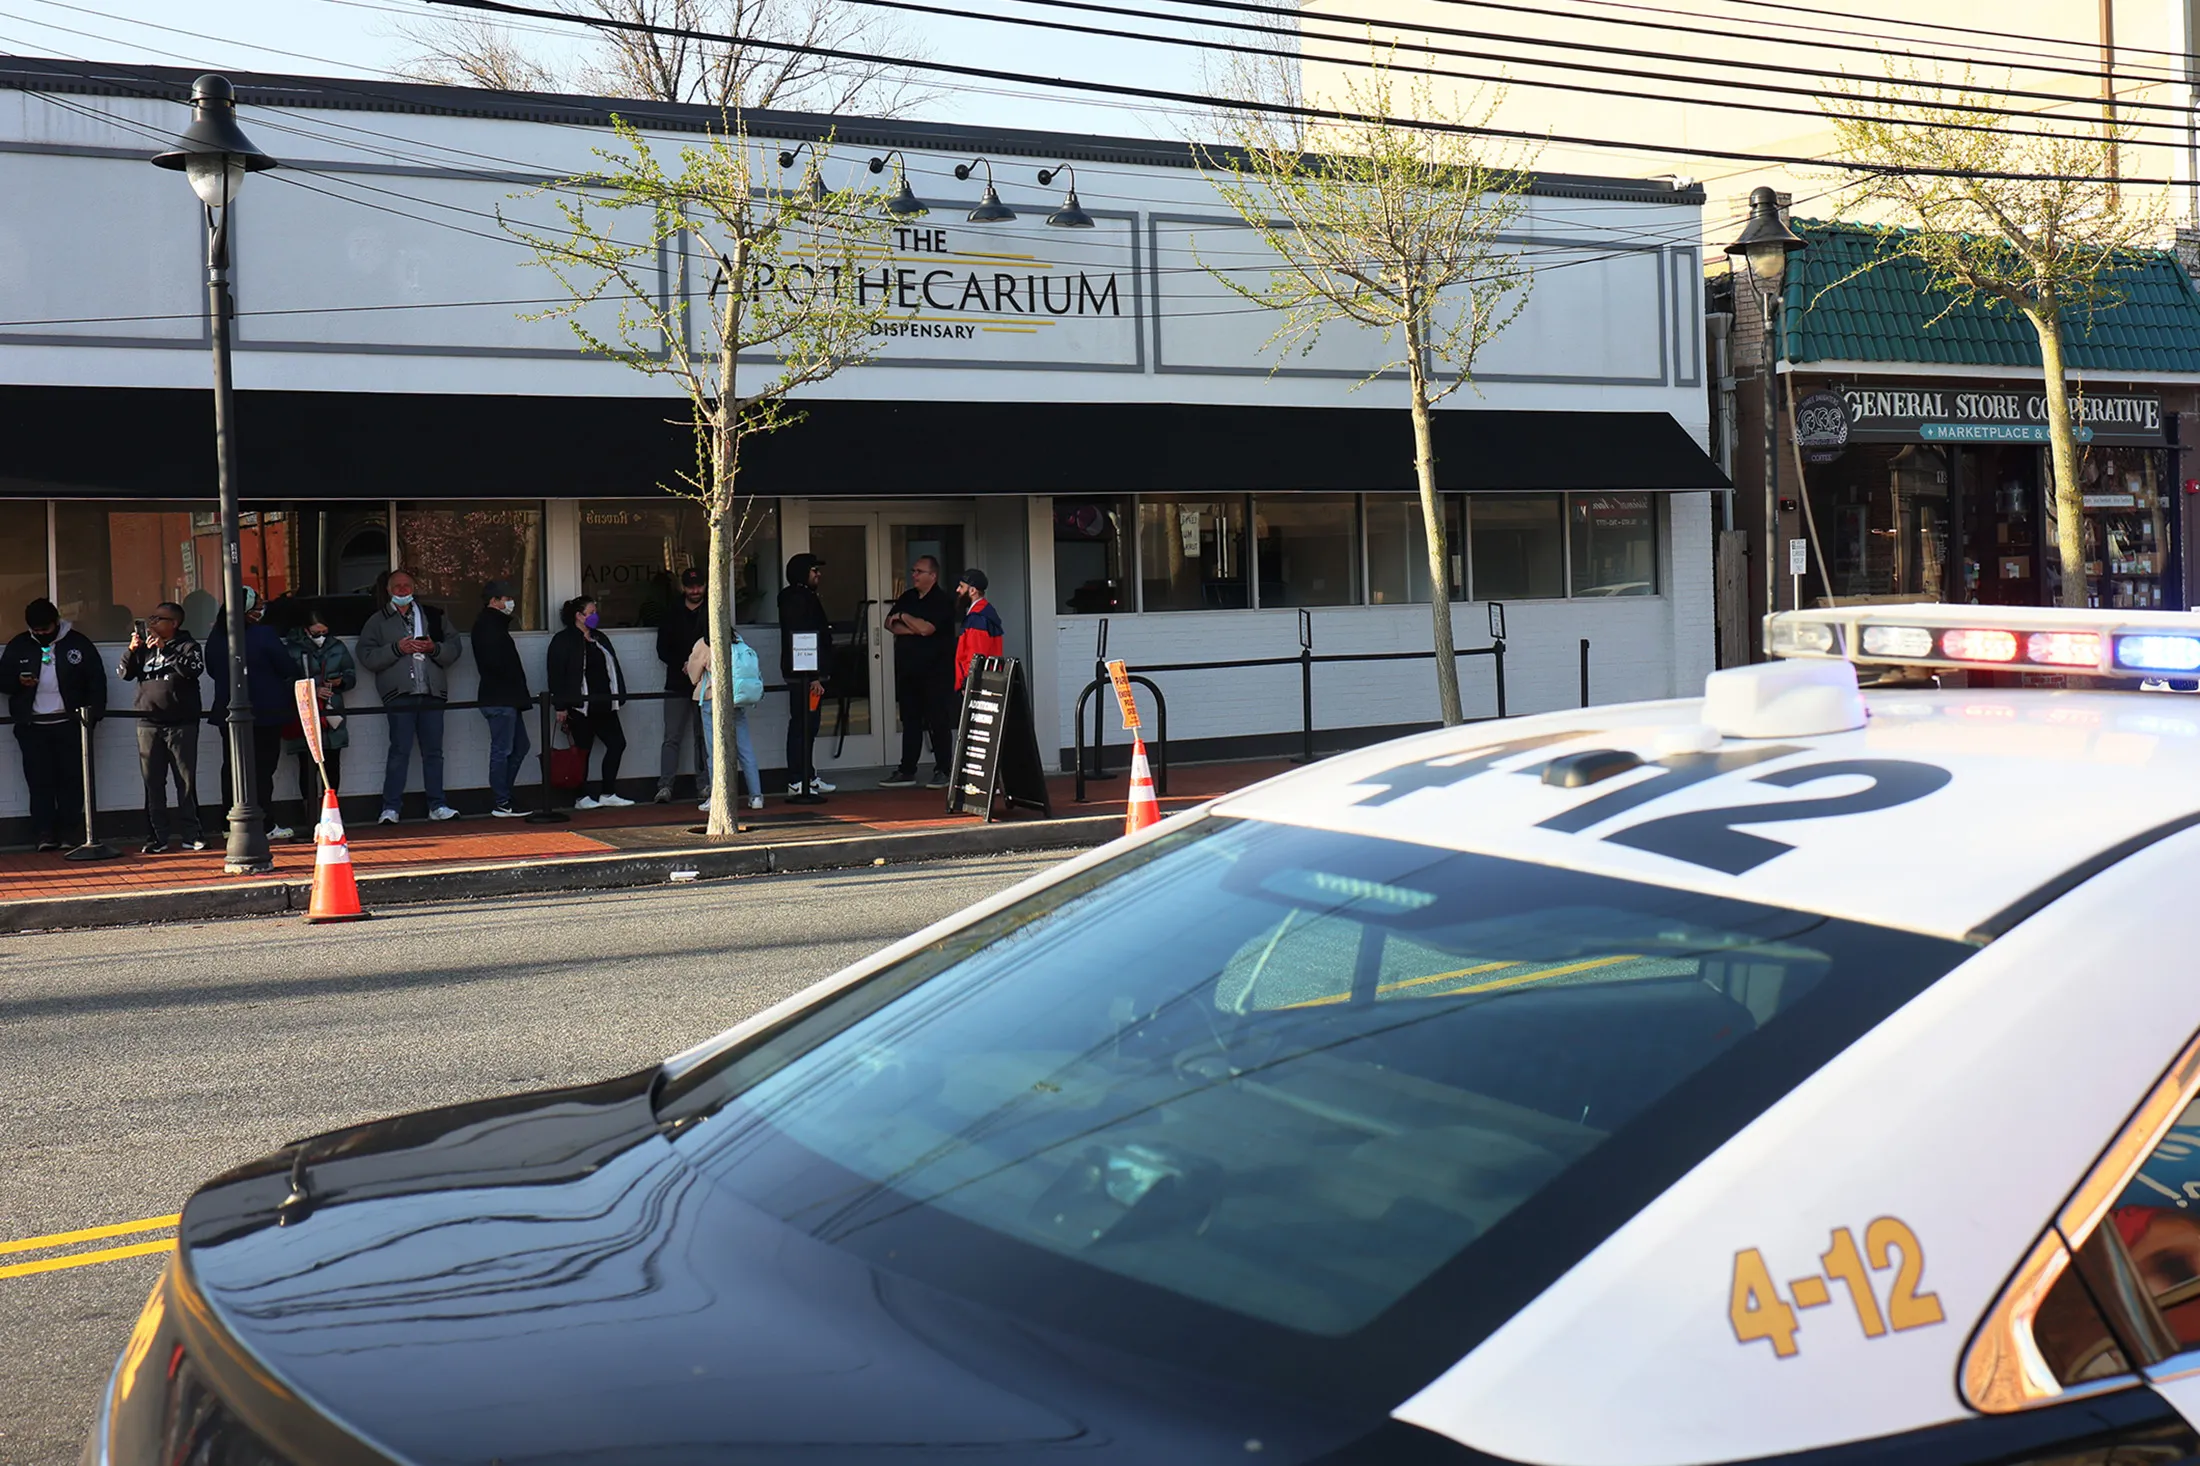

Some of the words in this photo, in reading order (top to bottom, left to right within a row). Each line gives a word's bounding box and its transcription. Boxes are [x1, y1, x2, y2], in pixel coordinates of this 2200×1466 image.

[893, 227, 948, 253] THE
[708, 253, 1120, 316] APOTHECARIUM
[870, 322, 976, 339] DISPENSARY
[1844, 391, 1948, 422] GENERAL
[1956, 393, 2021, 419] STORE
[2026, 396, 2160, 429] COPERATIVE
[1938, 427, 2030, 439] MARKETPLACE
[2034, 428, 2044, 439] &
[145, 673, 169, 681] AIR
[1728, 1214, 1947, 1360] 4-12
